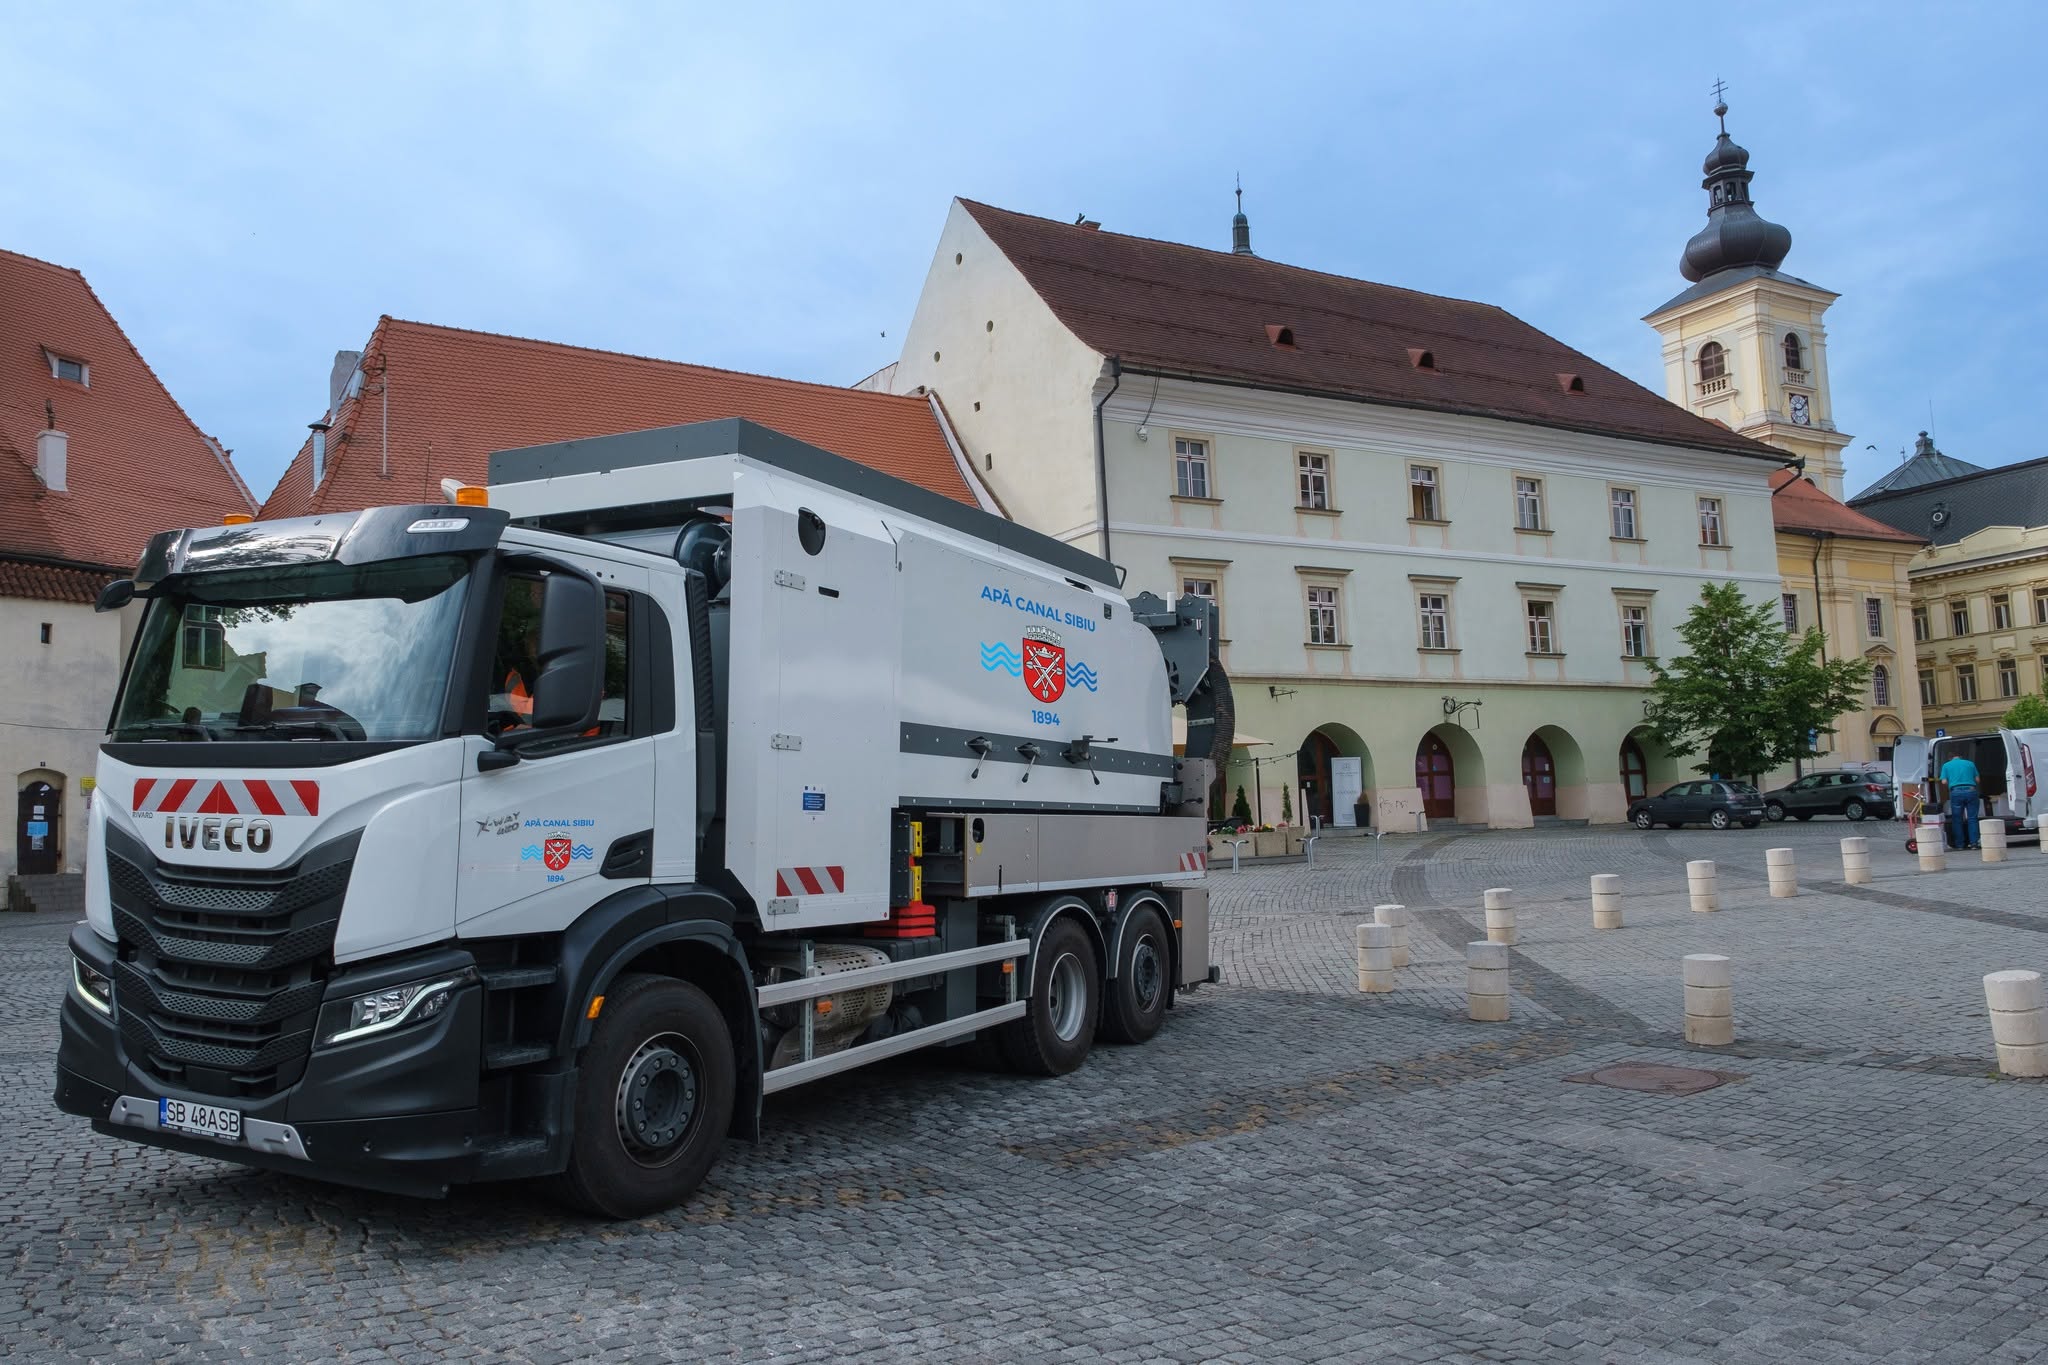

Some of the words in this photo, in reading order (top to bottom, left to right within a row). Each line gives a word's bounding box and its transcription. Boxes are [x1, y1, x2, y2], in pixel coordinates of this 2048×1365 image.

[981, 585, 1012, 607] APĂ
[1015, 597, 1062, 622] CANAL
[1064, 612, 1096, 632] SIBIU
[1031, 709, 1060, 726] 1894
[132, 811, 153, 819] RIVARD
[543, 819, 570, 827] CANAL
[573, 819, 595, 827] SIBIU
[165, 815, 273, 853] IVECO
[167, 1102, 186, 1122] SB
[191, 1106, 239, 1132] 48ASB
